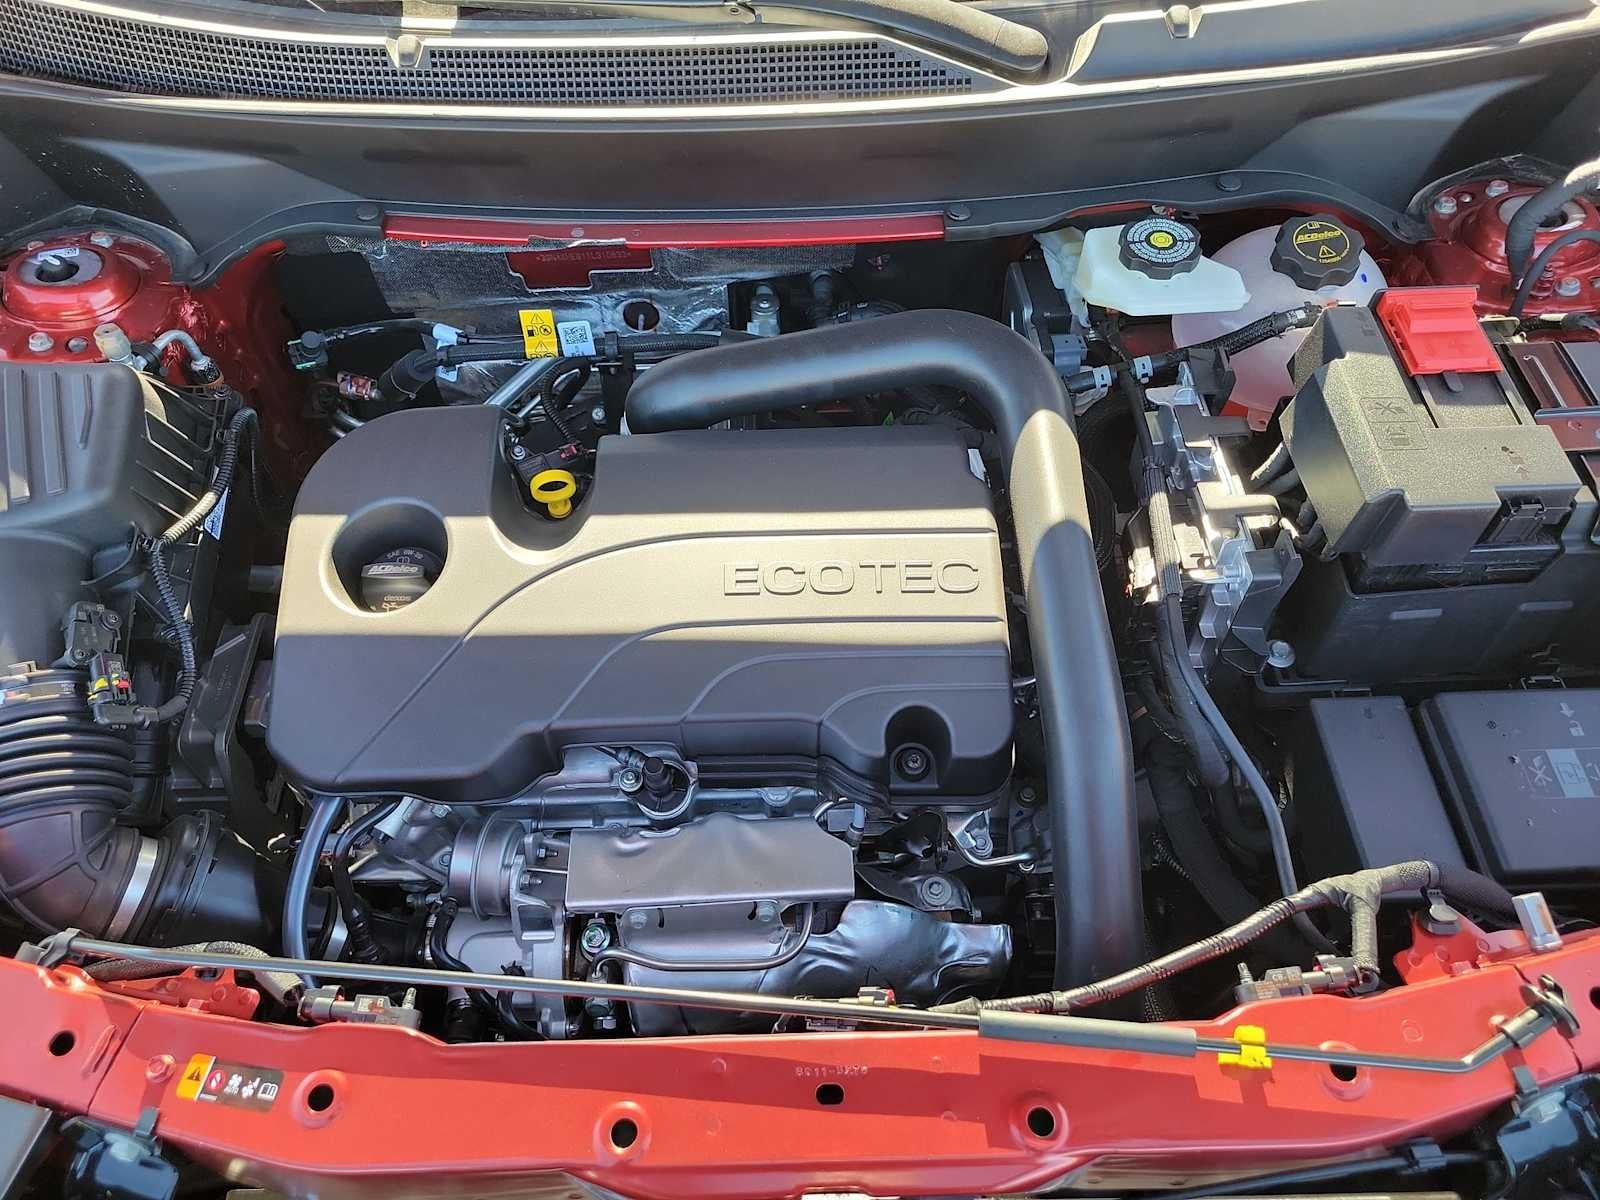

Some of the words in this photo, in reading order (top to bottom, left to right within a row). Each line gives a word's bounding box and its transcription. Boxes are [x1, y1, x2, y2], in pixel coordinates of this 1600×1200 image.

[1296, 230, 1341, 244] ACDelco
[368, 564, 418, 576] ACDelco
[723, 559, 980, 597] ECOTEC
